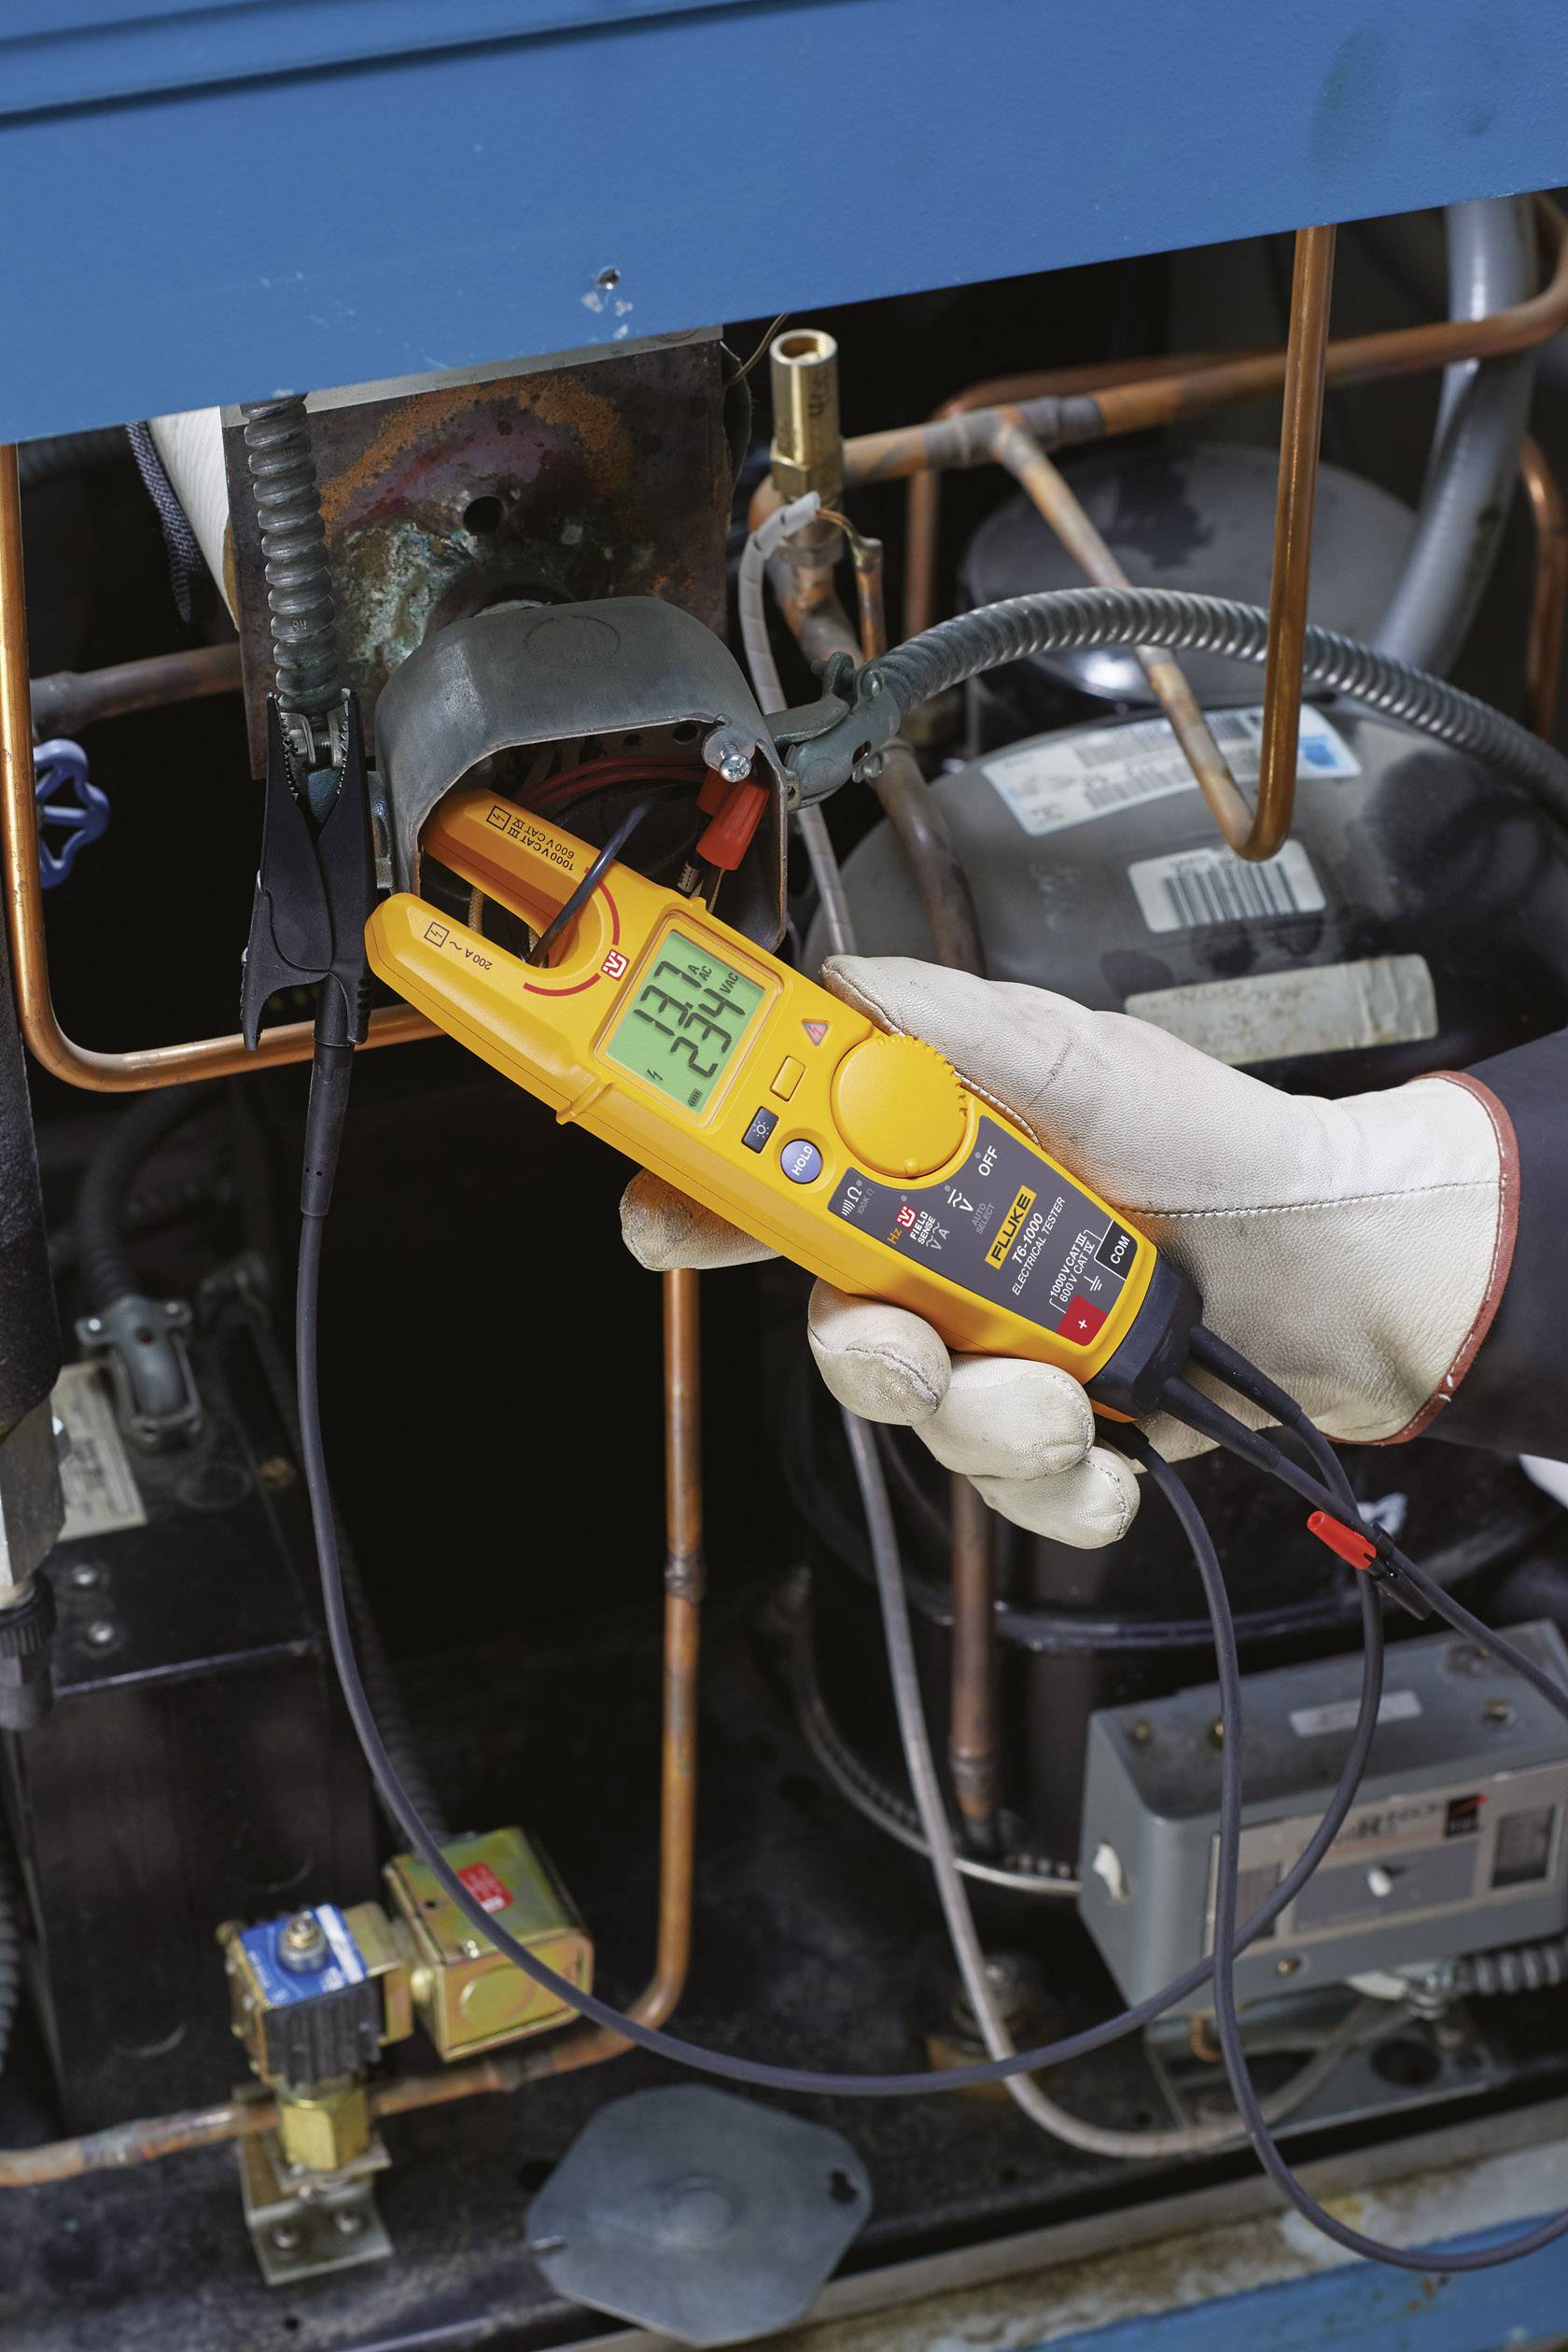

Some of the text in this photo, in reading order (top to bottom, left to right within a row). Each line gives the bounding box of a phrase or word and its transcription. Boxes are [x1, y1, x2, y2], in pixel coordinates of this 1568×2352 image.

[507, 826, 574, 871] 1000 V CAT III
[511, 817, 575, 860] 600 V CAT IV
[465, 948, 493, 971] 200 A
[698, 965, 713, 981] AC
[634, 960, 702, 1037] 13.7
[670, 988, 746, 1078] 234
[791, 1145, 813, 1176] HOLD
[978, 1145, 999, 1176] OFF
[909, 1211, 929, 1240] FIELD
[917, 1215, 936, 1245] SENSE
[972, 1202, 987, 1226] AUTO
[976, 1202, 996, 1235] SELECT
[990, 1194, 1031, 1261] FLUKE
[886, 1227, 903, 1245] Hz
[1012, 1212, 1043, 1264] T6-1000
[1012, 1197, 1066, 1295] ELECTRICAL TESTER
[1110, 1235, 1130, 1265] COM
[1050, 1273, 1067, 1297] 1000
[1065, 1244, 1080, 1267] CAT
[1075, 1232, 1087, 1248] III
[1059, 1240, 1096, 1302] 600 V CAT IV
